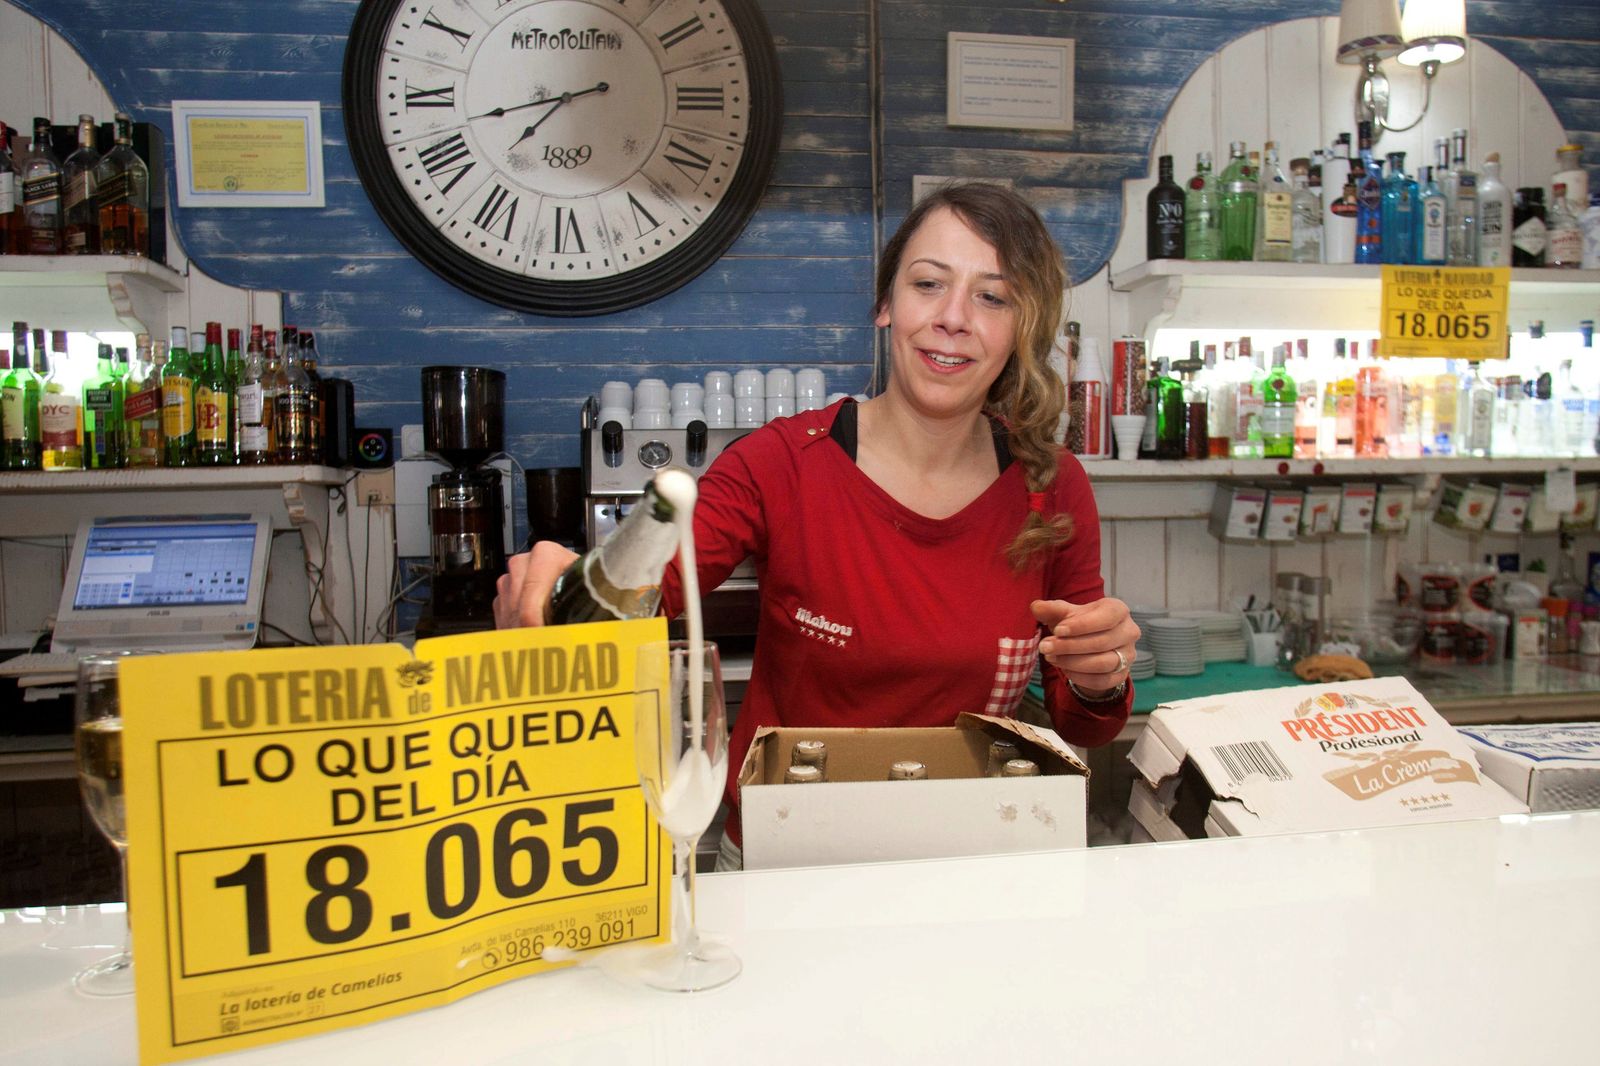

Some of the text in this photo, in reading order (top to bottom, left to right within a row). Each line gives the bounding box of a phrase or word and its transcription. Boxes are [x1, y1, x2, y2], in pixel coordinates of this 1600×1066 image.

[675, 81, 725, 118] III
[540, 144, 593, 170] 1889
[1397, 288, 1493, 299] LO QUE QUEDA
[1418, 300, 1439, 310] DEL
[1395, 312, 1491, 339] 18.065
[198, 642, 619, 731] LOTERIA de NAVIDAD
[1280, 706, 1428, 742] PRÉSIDENT
[1319, 730, 1423, 752] Profesional
[217, 705, 621, 787] LO QUE QUEDA
[331, 753, 531, 827] DEL DÍA
[1353, 758, 1433, 795] La Crèm
[214, 798, 620, 957] 18.065
[499, 932, 512, 943] las
[515, 921, 556, 939] Camelias
[558, 917, 576, 929] 110
[595, 909, 623, 923] 36211
[625, 905, 648, 917] VIGO
[505, 918, 635, 963] 986 239 091
[219, 1002, 240, 1016] La
[306, 987, 326, 1000] de
[331, 971, 402, 996] Camelias
